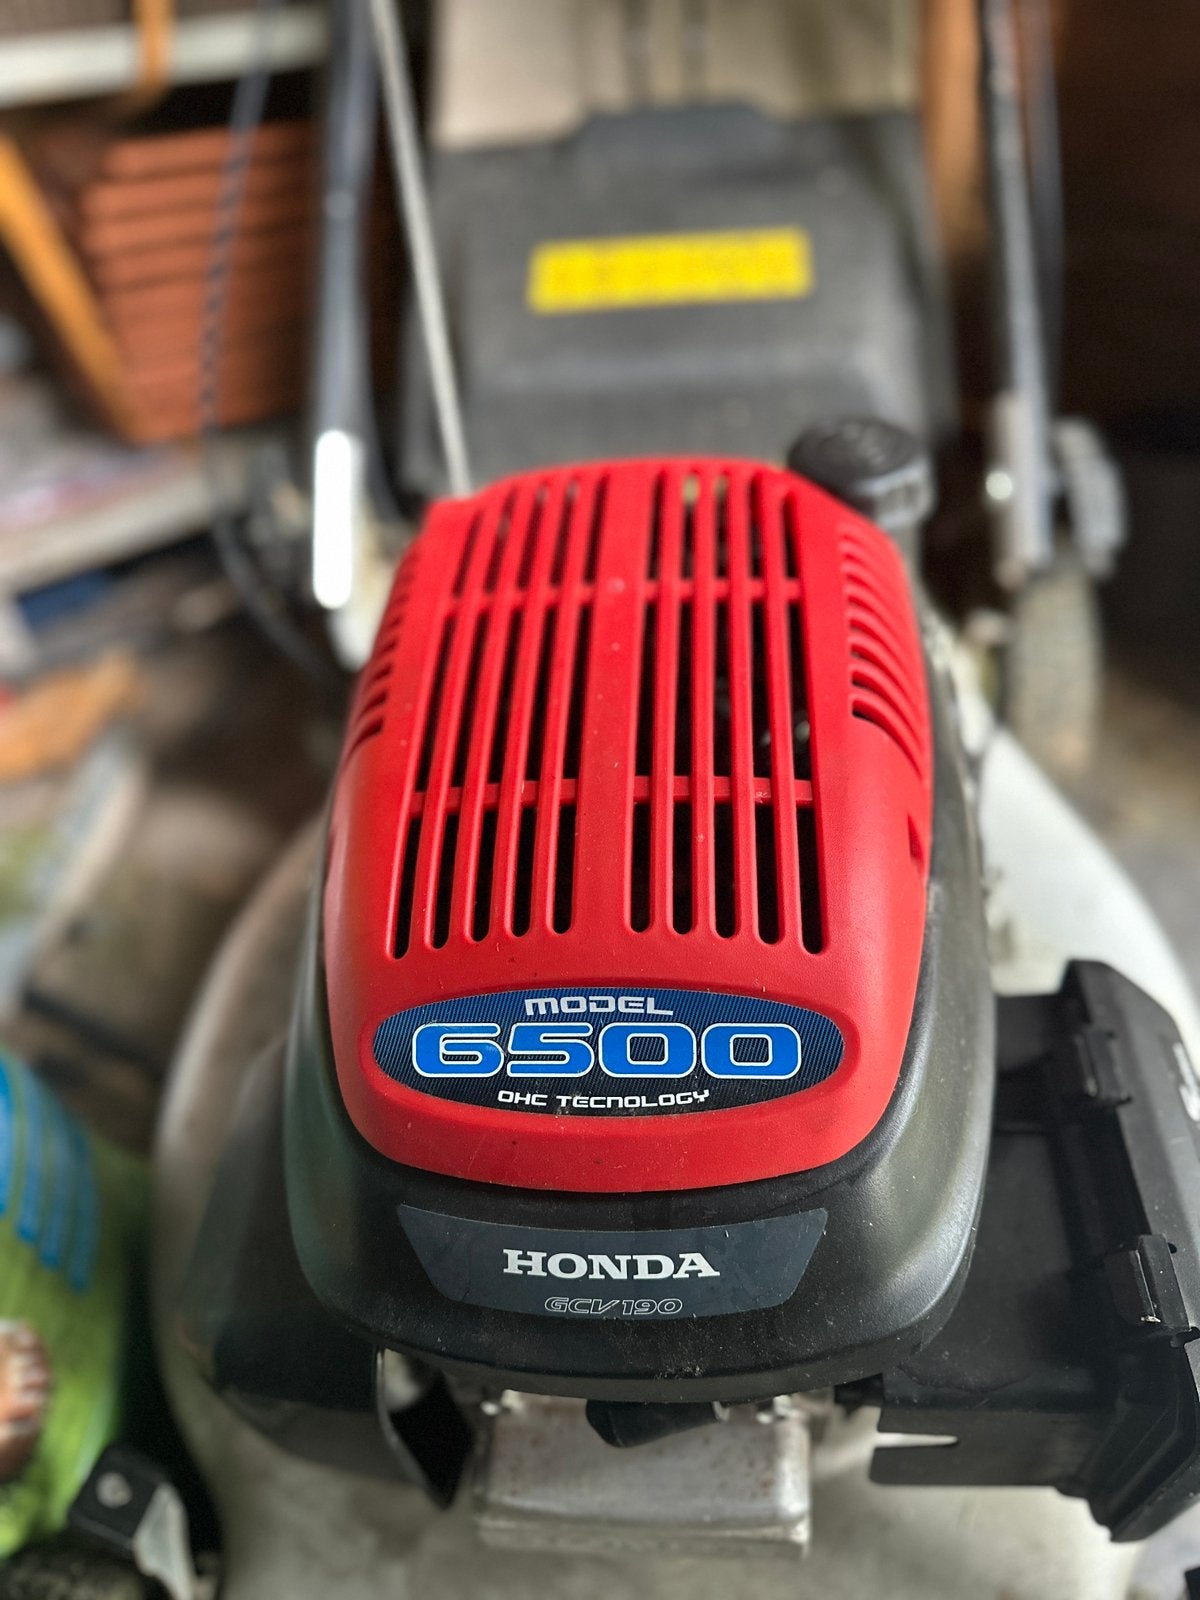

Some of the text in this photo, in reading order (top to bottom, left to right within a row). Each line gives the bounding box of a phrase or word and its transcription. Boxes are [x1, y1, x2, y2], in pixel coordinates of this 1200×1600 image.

[525, 996, 674, 1016] MODEL
[411, 1022, 802, 1079] 6500
[498, 1089, 710, 1109] OHC TECNOLOGY
[503, 1248, 720, 1280] HONDA
